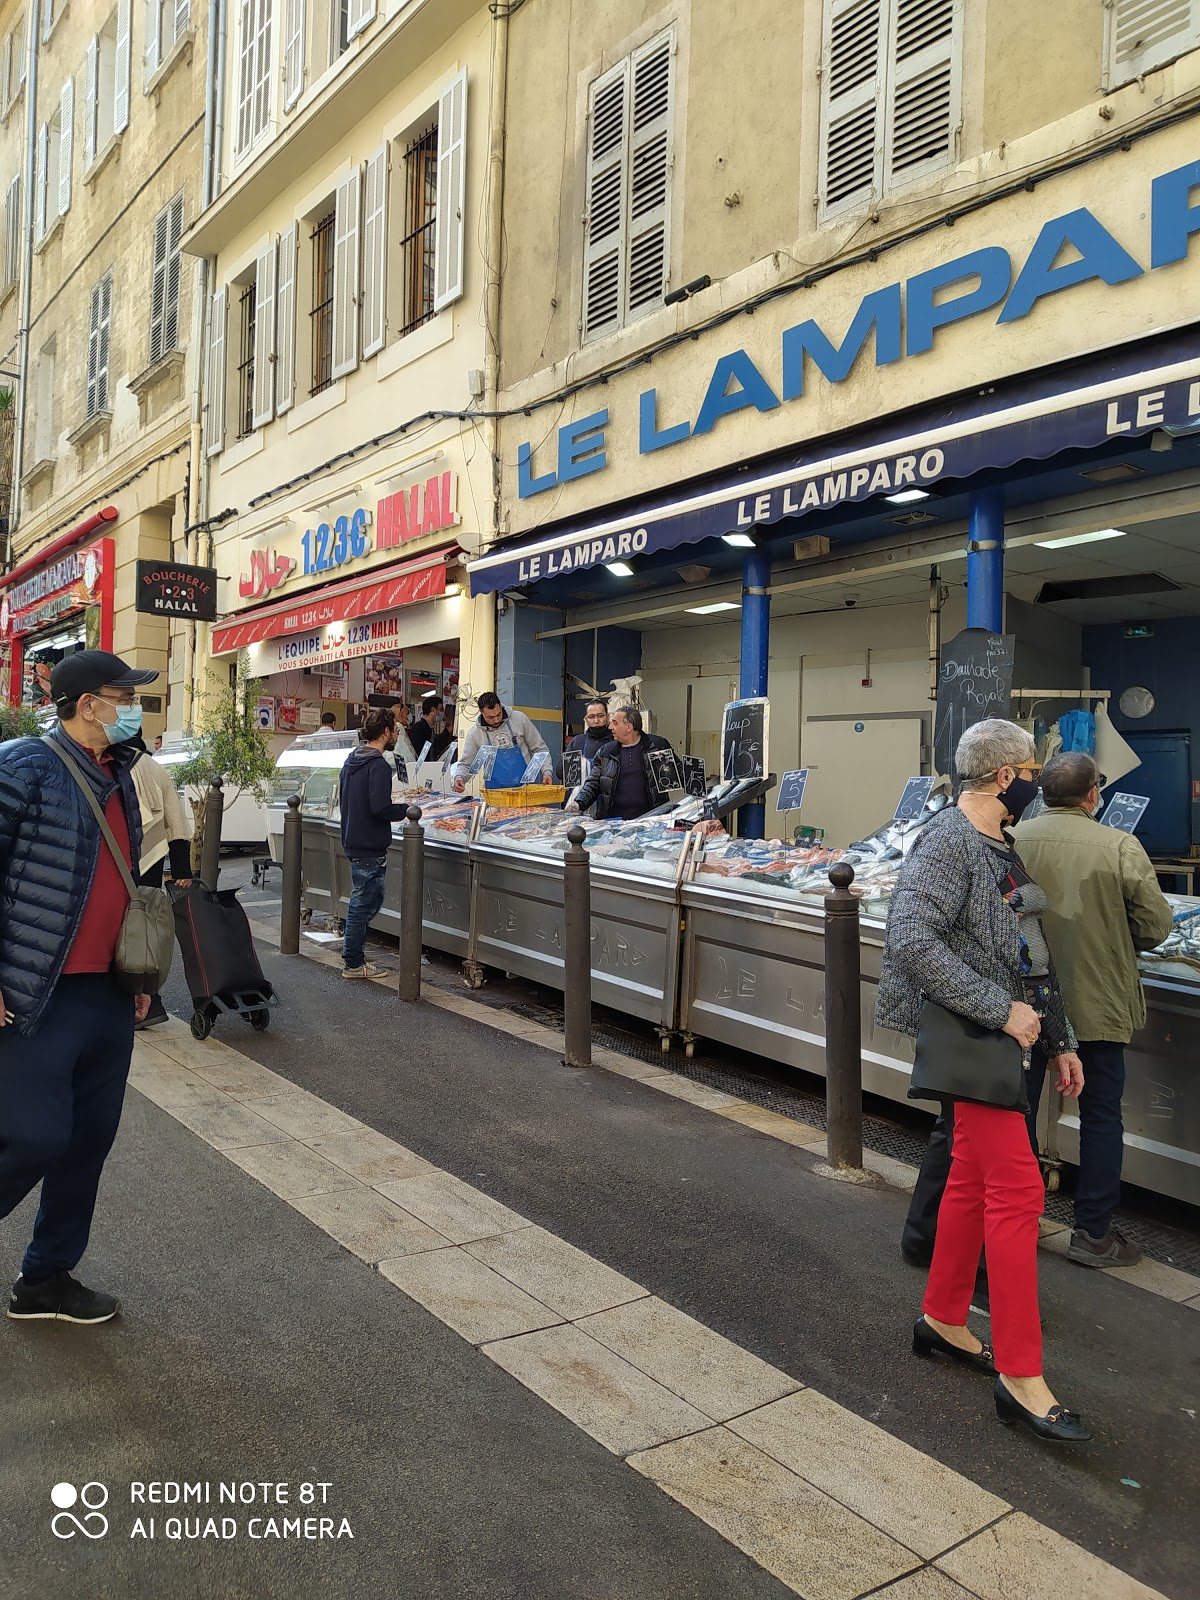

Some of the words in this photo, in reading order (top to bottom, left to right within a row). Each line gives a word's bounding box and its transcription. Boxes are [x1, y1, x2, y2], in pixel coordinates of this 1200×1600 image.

[1106, 390, 1165, 435] LE
[518, 408, 608, 499] LE
[737, 494, 771, 526] LE
[783, 448, 945, 514] LAMPARO
[376, 470, 459, 550] HALAL
[239, 547, 293, 598] حلال
[518, 556, 541, 581] LE
[547, 528, 648, 574] LAMPARO
[143, 571, 211, 594] BOUCHERIE
[154, 598, 198, 612] HALAL
[371, 618, 399, 640] HALAL
[278, 659, 297, 670] VOUS
[335, 650, 345, 659] LA
[347, 639, 399, 657] BIENVENUE
[726, 709, 751, 738] loup
